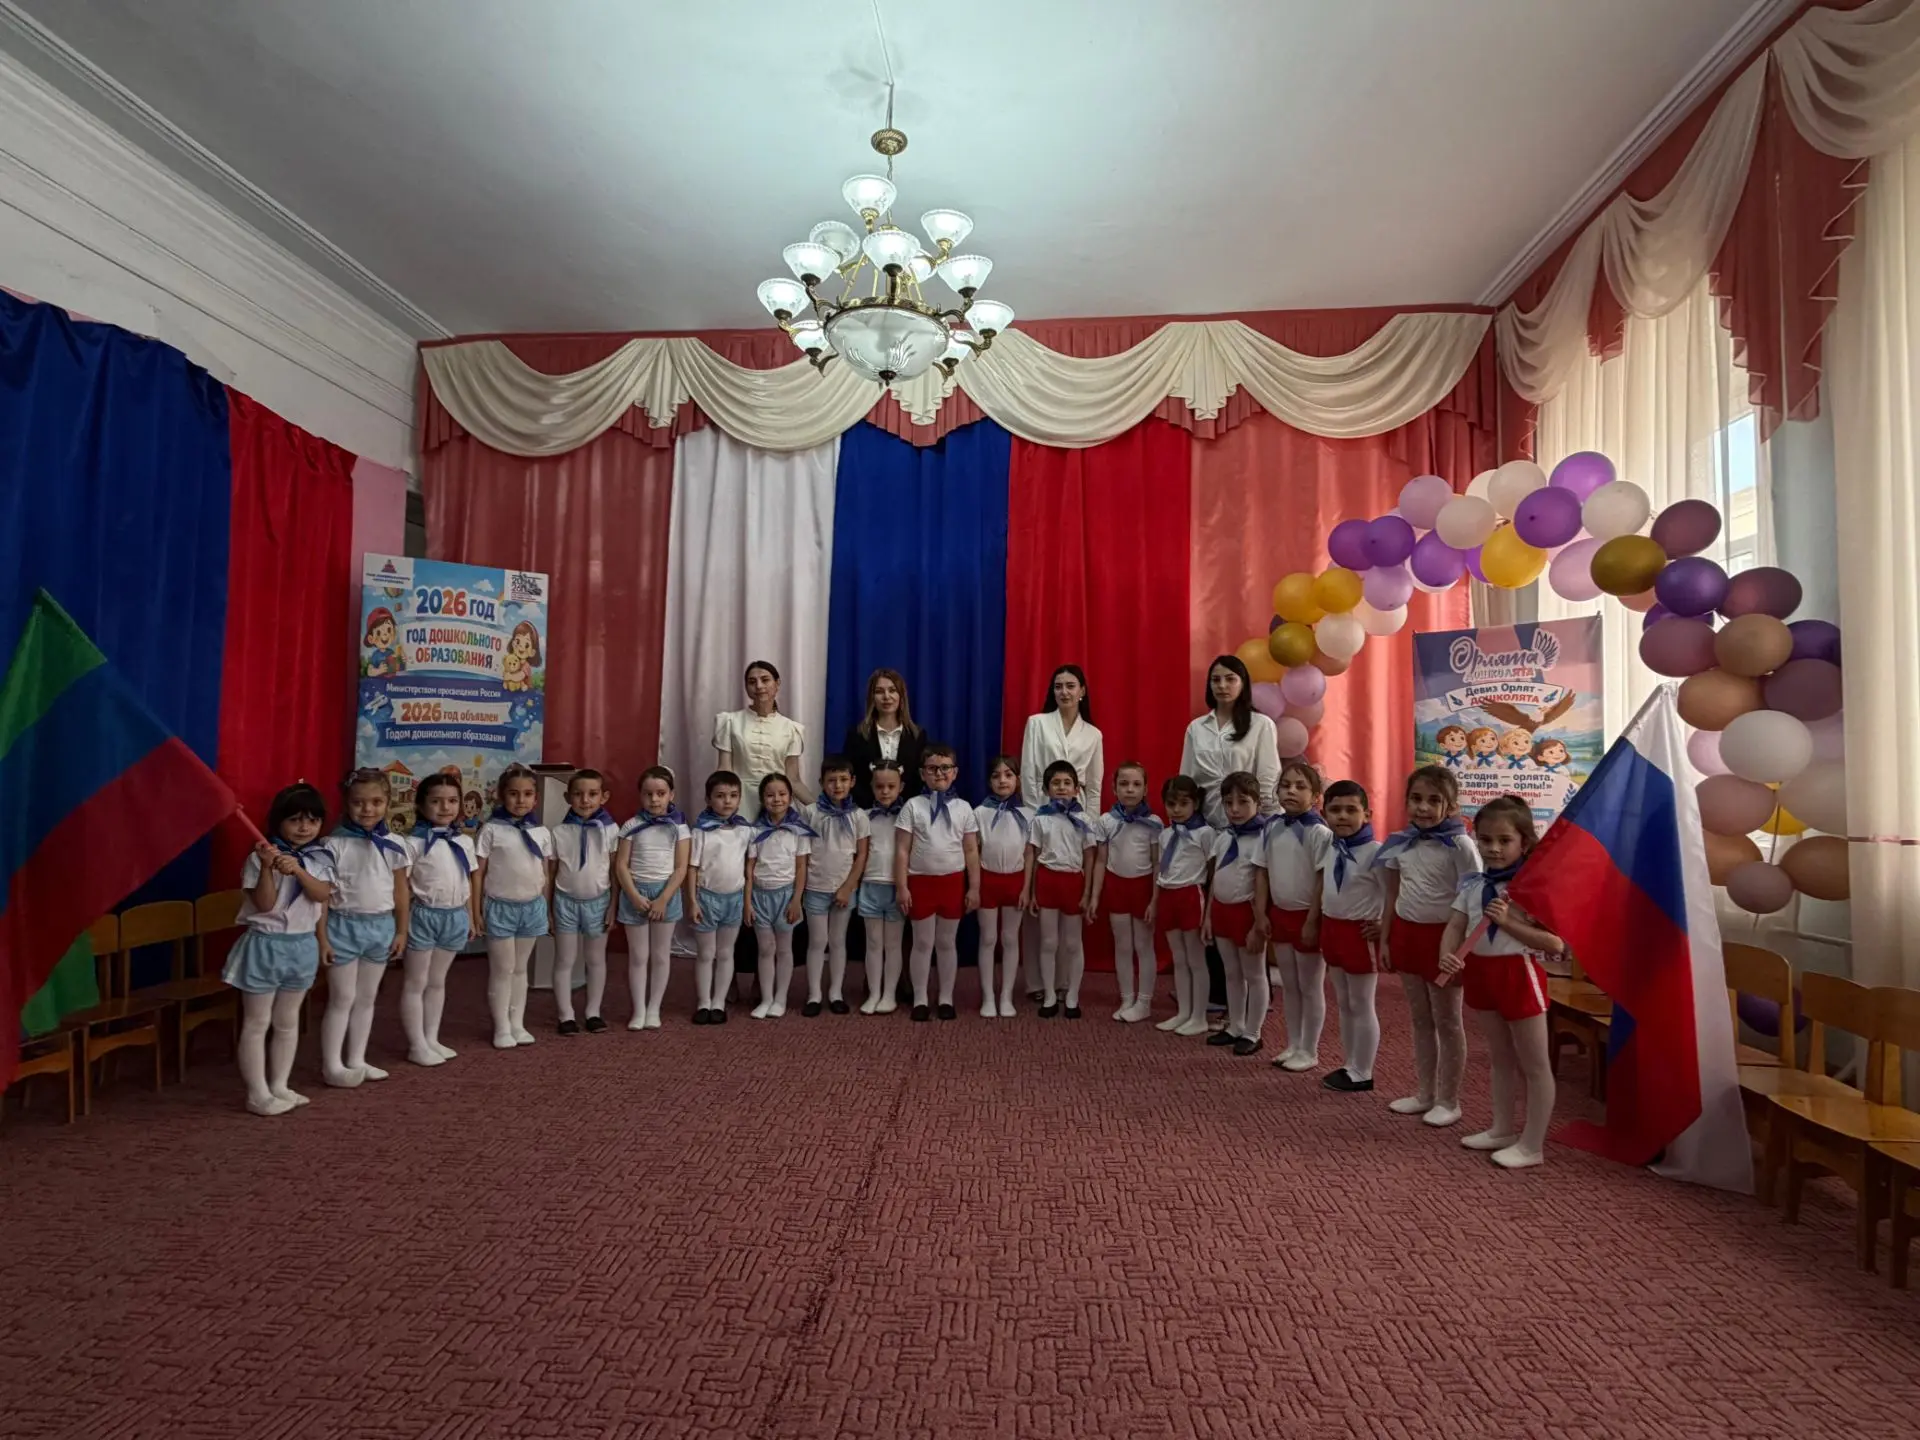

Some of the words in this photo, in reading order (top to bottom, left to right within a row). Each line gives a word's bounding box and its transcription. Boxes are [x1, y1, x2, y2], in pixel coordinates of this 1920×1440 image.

[416, 588, 467, 617] 2026
[406, 628, 427, 645] ГОД
[429, 628, 502, 652] ДОШКОЛЬНОГО
[415, 647, 493, 669] ОБРАЗОВАНИЯ
[1452, 637, 1538, 674] Орлята
[386, 683, 436, 695] Министерством
[438, 686, 479, 697] просвещения
[480, 688, 501, 697] России
[1465, 685, 1498, 697] Девиз
[1501, 683, 1536, 693] Орлят
[1471, 693, 1539, 706] ДОШКОЛЯТА
[401, 702, 442, 722] 2026
[443, 711, 459, 722] год
[460, 709, 499, 722] объявлен
[385, 727, 411, 739] Годом
[412, 730, 461, 740] дошкольного
[462, 729, 506, 743] образования
[1465, 781, 1499, 790] завтра
[1513, 773, 1554, 783] орлята,
